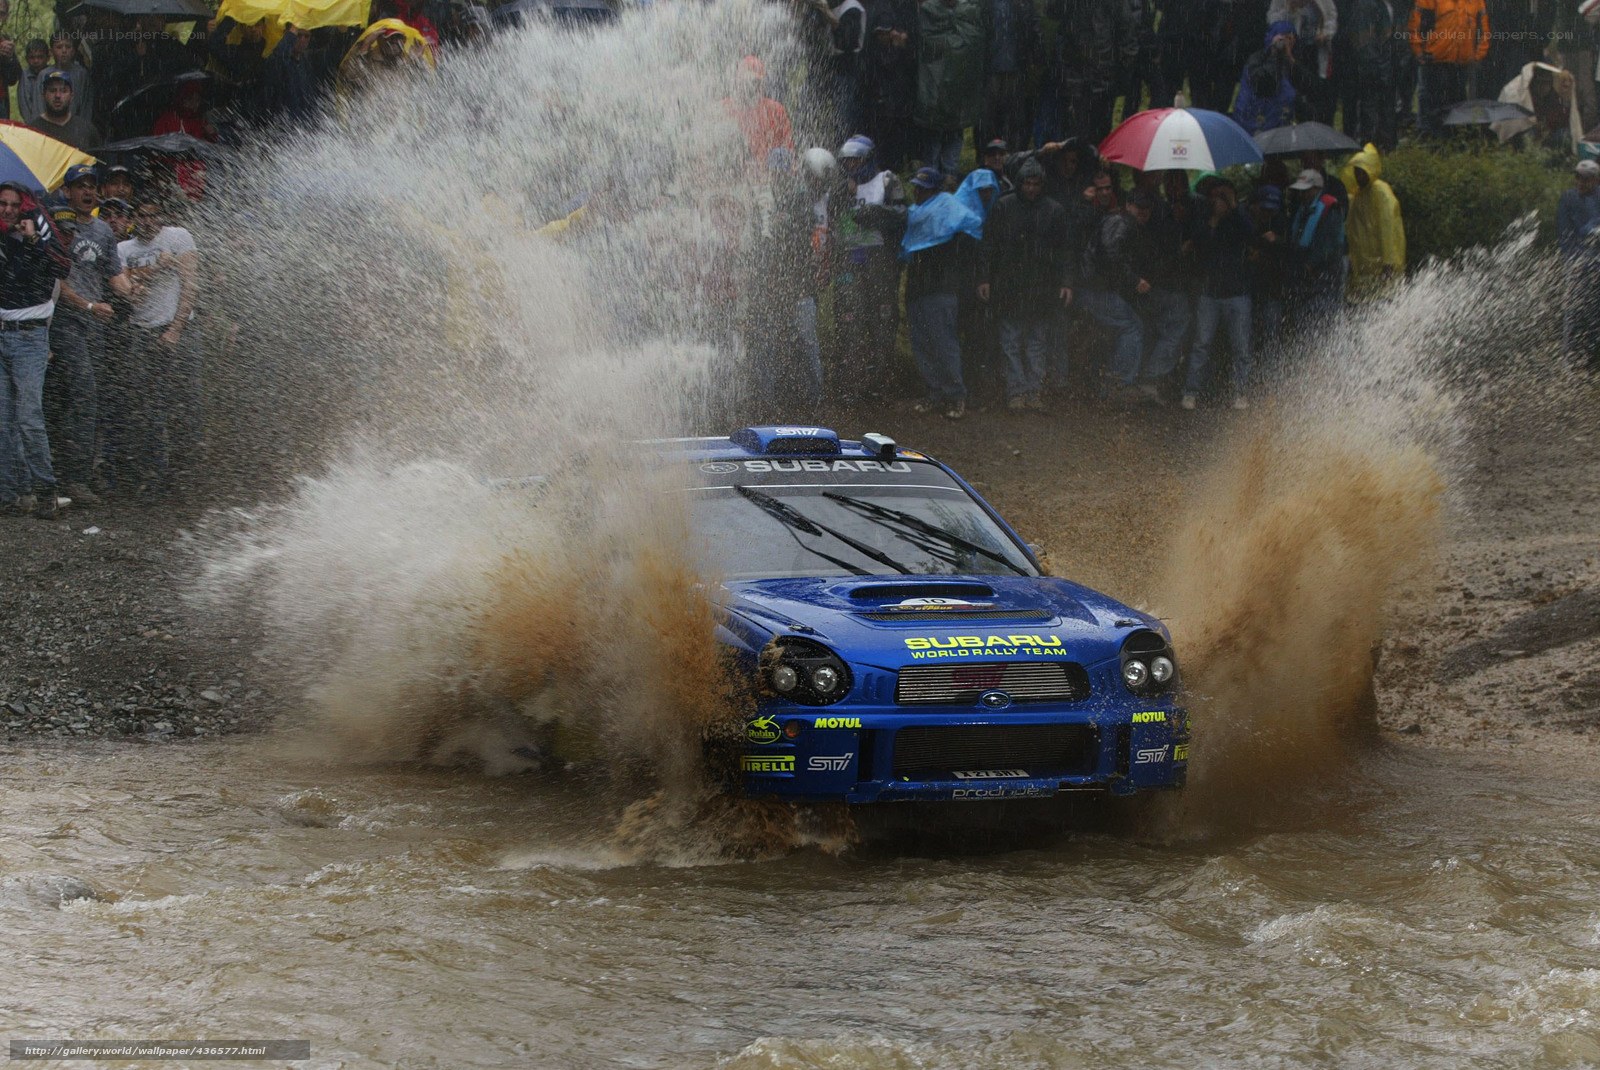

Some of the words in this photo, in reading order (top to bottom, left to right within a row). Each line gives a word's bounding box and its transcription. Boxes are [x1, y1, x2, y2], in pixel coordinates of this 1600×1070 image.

[744, 460, 912, 473] SUBARU
[905, 635, 1061, 649] SUBARU
[911, 649, 969, 659] WORLD
[973, 648, 1018, 656] RALLY
[1023, 647, 1067, 656] TEAM
[814, 717, 862, 729] MOTUL
[1131, 711, 1167, 723] MOTUL
[748, 729, 776, 739] Robin
[740, 755, 796, 771] PIRELLI
